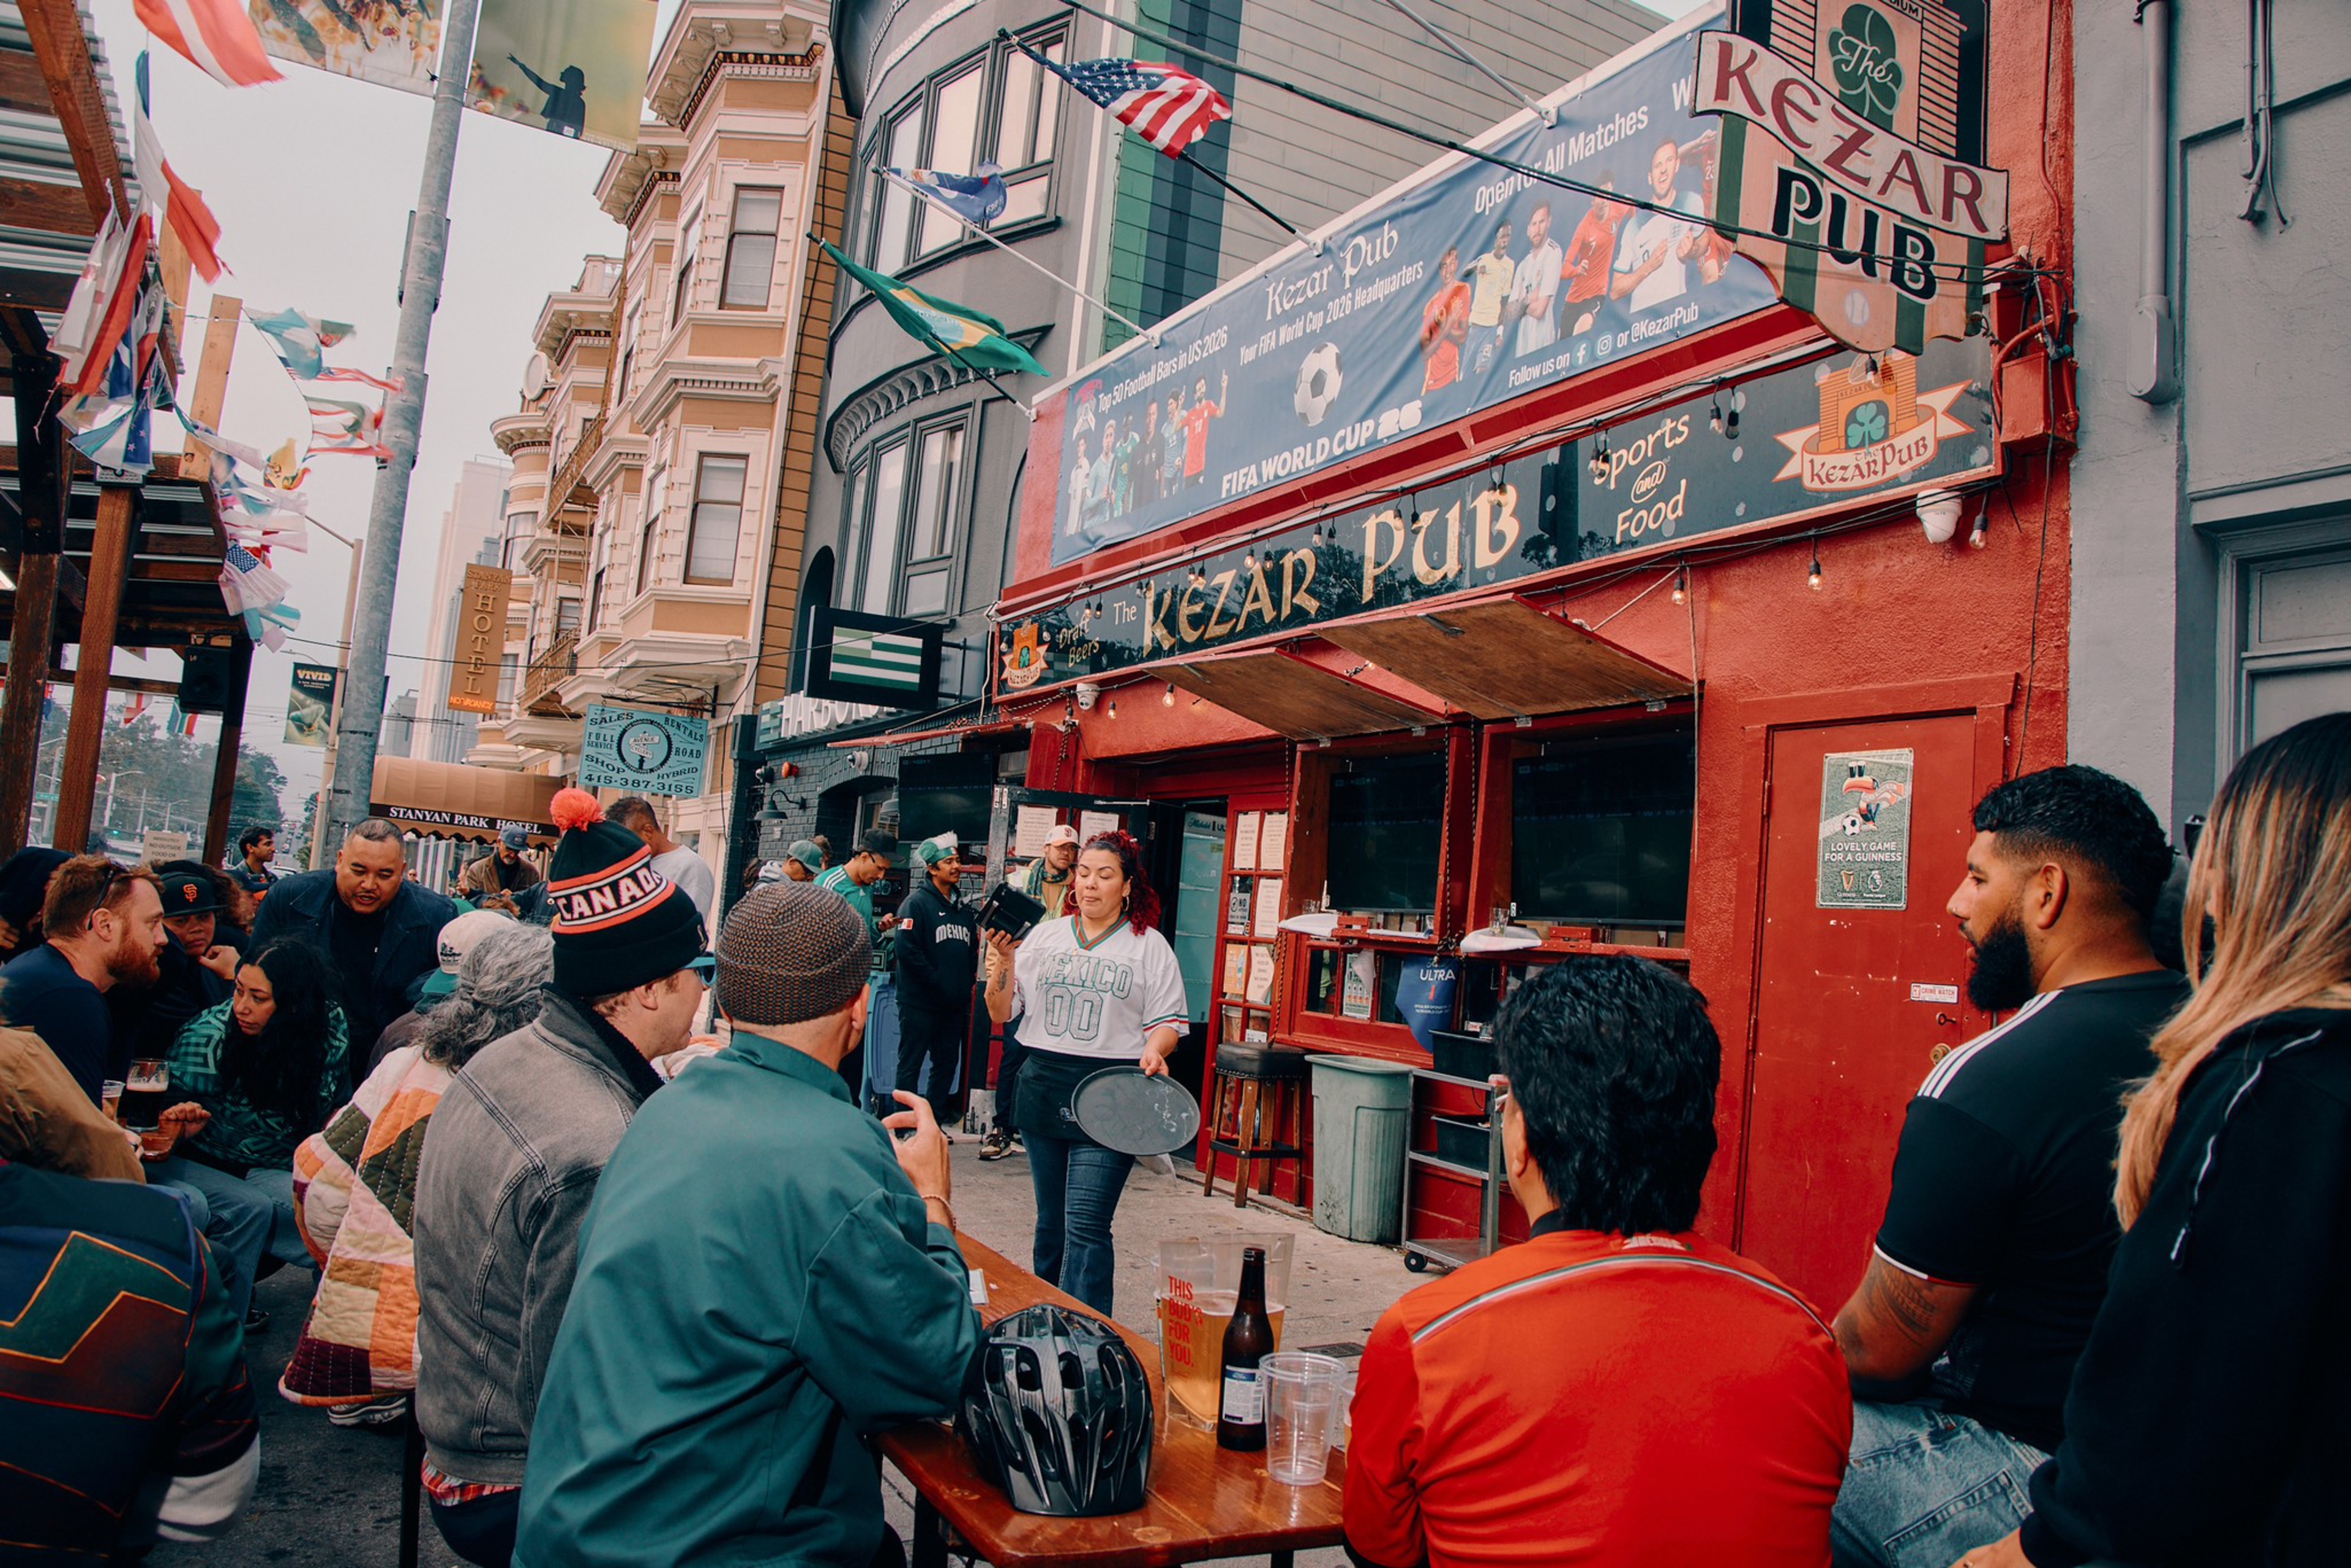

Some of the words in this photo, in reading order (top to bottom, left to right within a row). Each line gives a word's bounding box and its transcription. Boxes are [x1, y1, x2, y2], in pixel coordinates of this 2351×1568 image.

[1838, 36, 1893, 83] The
[1714, 40, 1990, 234] KEZAR
[1475, 176, 1515, 216] Open
[1517, 158, 1542, 193] for
[1543, 140, 1566, 176] All
[1568, 105, 1649, 167] Matches
[1772, 166, 1938, 301] PUB
[1265, 263, 1333, 321] Kezar
[1340, 220, 1398, 290] Pub
[1240, 343, 1258, 366] Your
[1259, 331, 1276, 356] FIFA
[1280, 315, 1303, 346] World
[1306, 310, 1324, 333] Cup
[1326, 293, 1352, 324] 2026
[1354, 260, 1424, 311] Headquarters
[1508, 358, 1542, 389] Follow
[1542, 358, 1555, 378] us
[1556, 352, 1570, 375] on
[1616, 331, 1630, 348] or
[1631, 302, 1699, 343] @KezarPub
[1098, 391, 1111, 413] Top
[1112, 383, 1123, 405] 50
[1123, 366, 1156, 400] Football
[1156, 358, 1178, 382] Bars
[1178, 351, 1187, 370] in
[1187, 340, 1202, 365] US
[1202, 324, 1228, 360] 2026
[1220, 463, 1258, 499] FIFA
[1261, 437, 1330, 483] WORLD
[1332, 419, 1375, 456] CUP
[1376, 399, 1423, 441] 26
[1593, 414, 1690, 490] Sports
[1809, 458, 1880, 486] KEZAR
[1879, 436, 1929, 477] PUB
[1635, 463, 1663, 495] and
[1615, 478, 1687, 545] Food
[467, 568, 511, 585] STANYAN
[1113, 600, 1138, 626] The
[1142, 547, 1321, 658] KEZAR
[1361, 482, 1521, 605] PUB
[474, 580, 502, 593] PARK
[463, 592, 497, 696] HOTEL
[1059, 613, 1090, 649] Draft
[1068, 635, 1100, 668] Beers
[296, 669, 332, 681] VIVID
[589, 712, 634, 726] SALES
[664, 716, 705, 743] RENTALS
[587, 732, 615, 743] FULL
[587, 740, 613, 750] SERVICE
[585, 754, 626, 775] SHOP
[674, 746, 702, 759] ROAD
[584, 773, 695, 795] 415-387-3155
[656, 767, 699, 780] HYBRID
[389, 806, 451, 825] STANYAN
[453, 814, 490, 828] PARK
[495, 819, 542, 835] HOTEL
[1824, 852, 1845, 862] FOR
[1845, 852, 1854, 862] A
[1854, 852, 1902, 862] GUINNESS
[1831, 842, 1868, 852] LOVELY
[1869, 841, 1897, 851] GAME
[935, 922, 970, 943] MEXIC
[1419, 969, 1456, 981] ULTRA
[1044, 985, 1104, 1041] 00
[1168, 1275, 1194, 1302] THIS
[1168, 1297, 1204, 1327] BUD'S
[1168, 1319, 1191, 1345] FOR
[1168, 1339, 1194, 1368] YOU.
